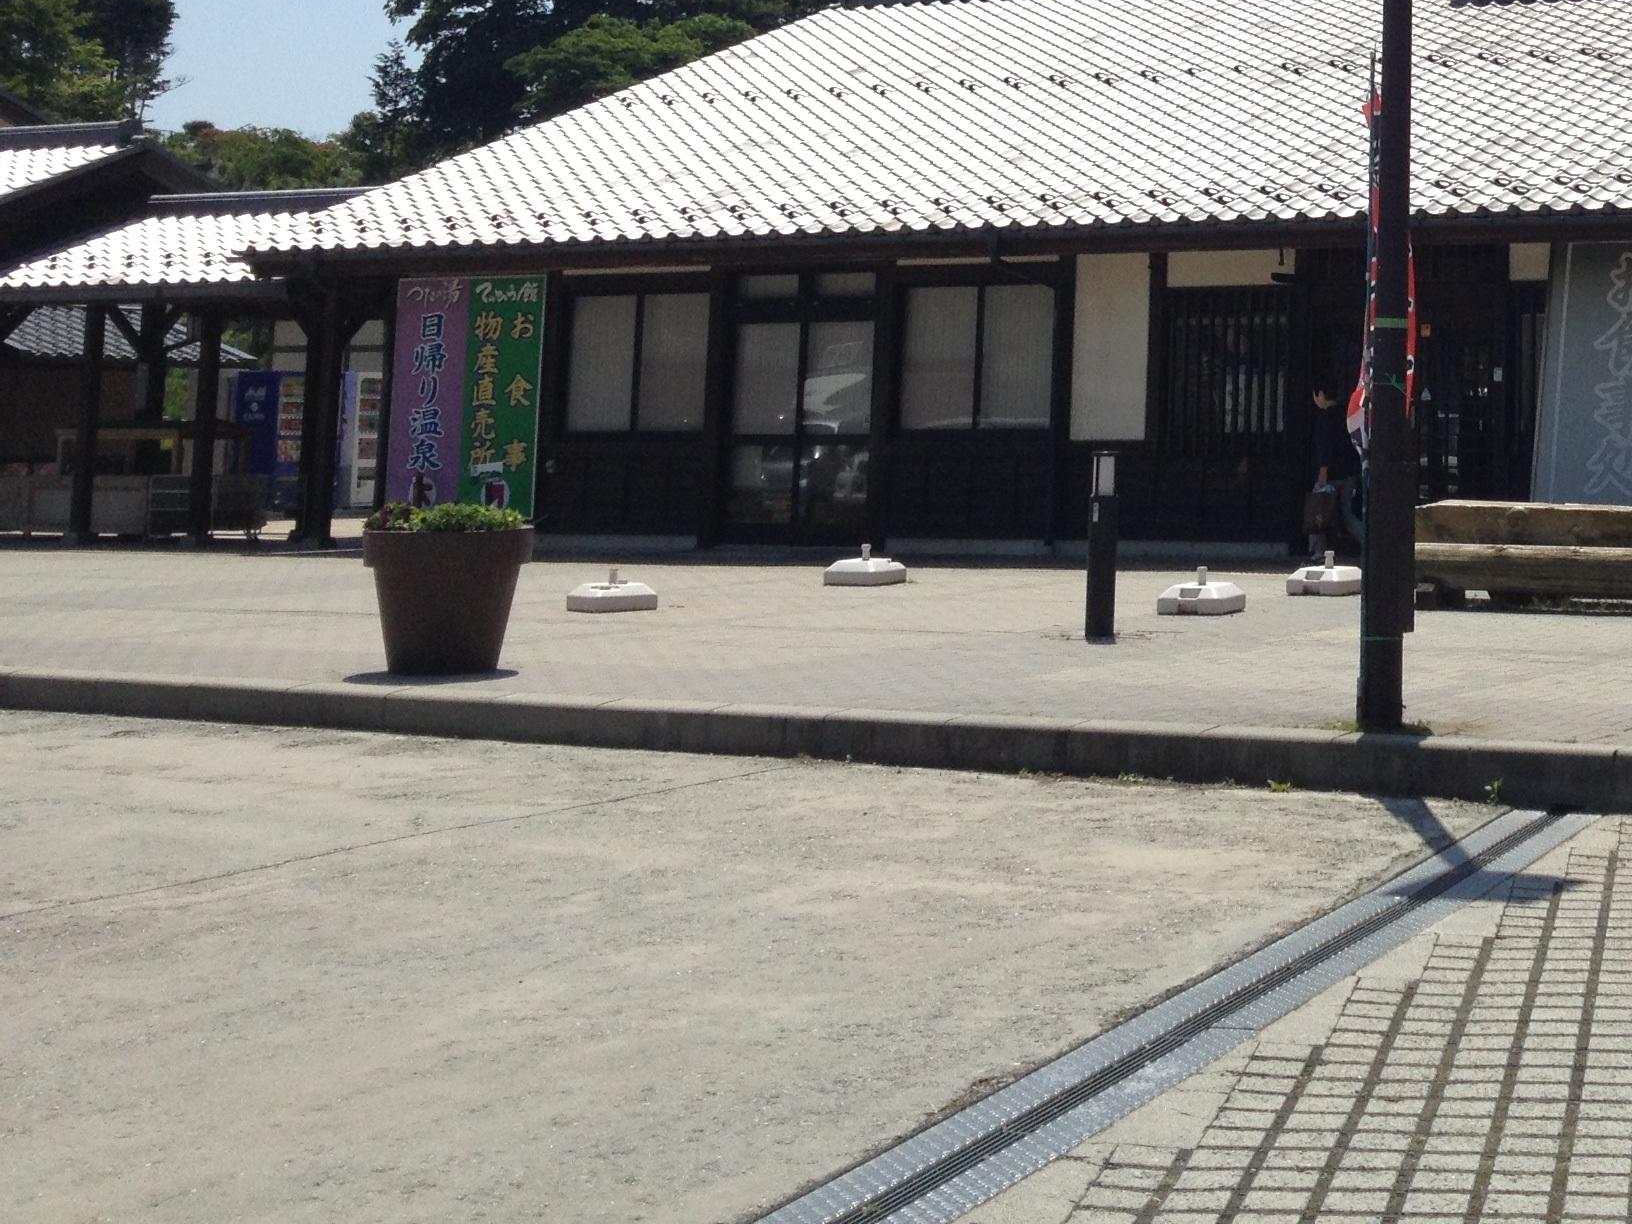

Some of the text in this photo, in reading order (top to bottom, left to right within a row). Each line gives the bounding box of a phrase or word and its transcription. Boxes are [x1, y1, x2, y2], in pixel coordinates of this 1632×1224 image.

[406, 312, 448, 473] 日帰り温泉
[469, 311, 503, 468] 物産直売所
